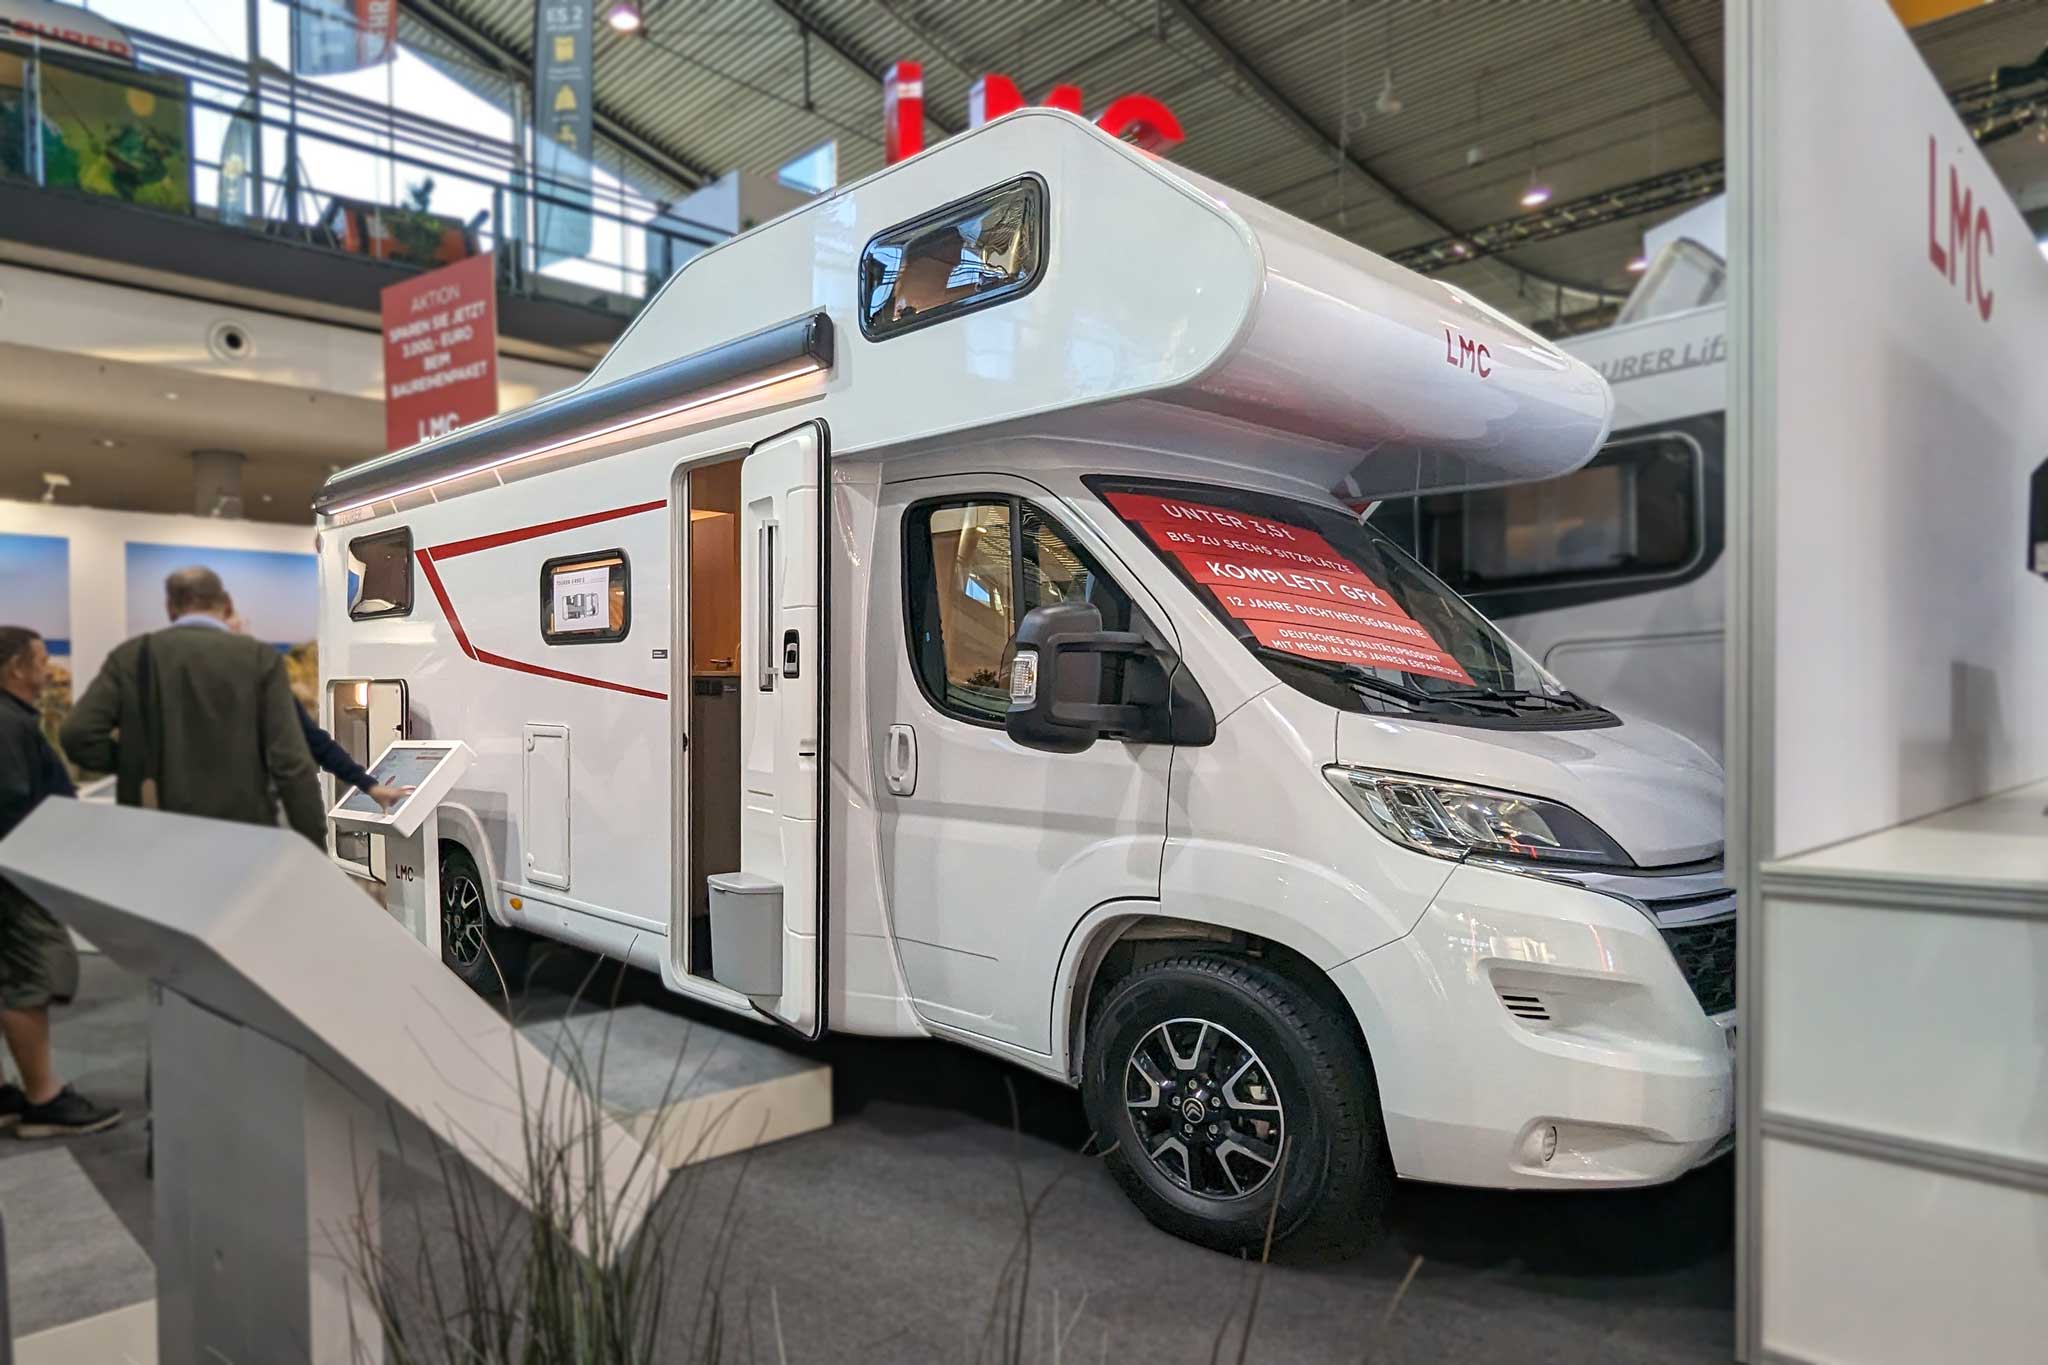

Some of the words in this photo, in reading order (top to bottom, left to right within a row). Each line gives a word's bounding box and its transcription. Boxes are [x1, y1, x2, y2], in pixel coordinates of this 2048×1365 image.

[1929, 134, 1994, 322] LMC
[411, 285, 461, 313] AKTION
[452, 300, 486, 324] JETZT
[1446, 328, 1491, 378] LMC
[1592, 347, 1676, 380] URER
[1161, 503, 1248, 530] UNTER
[1248, 519, 1296, 541] 3,5t
[1166, 531, 1195, 543] BIS
[1197, 535, 1221, 547] ZU
[1223, 539, 1272, 556] SECHS
[1273, 548, 1354, 575] SITZPLÄTZE
[1206, 560, 1336, 595] KOMPLETT
[1339, 584, 1387, 607] GFK
[1226, 596, 1245, 607] 12
[1249, 598, 1294, 613] JAHRE
[1295, 604, 1427, 639] DICHTHEITSGARANTIE
[1271, 639, 1294, 649] MIT
[1295, 642, 1328, 653] MEHR
[1331, 646, 1352, 656] ALS
[1369, 652, 1408, 666] JAHREN
[1279, 628, 1346, 645] DEUTSCHES
[395, 863, 414, 882] LMC
